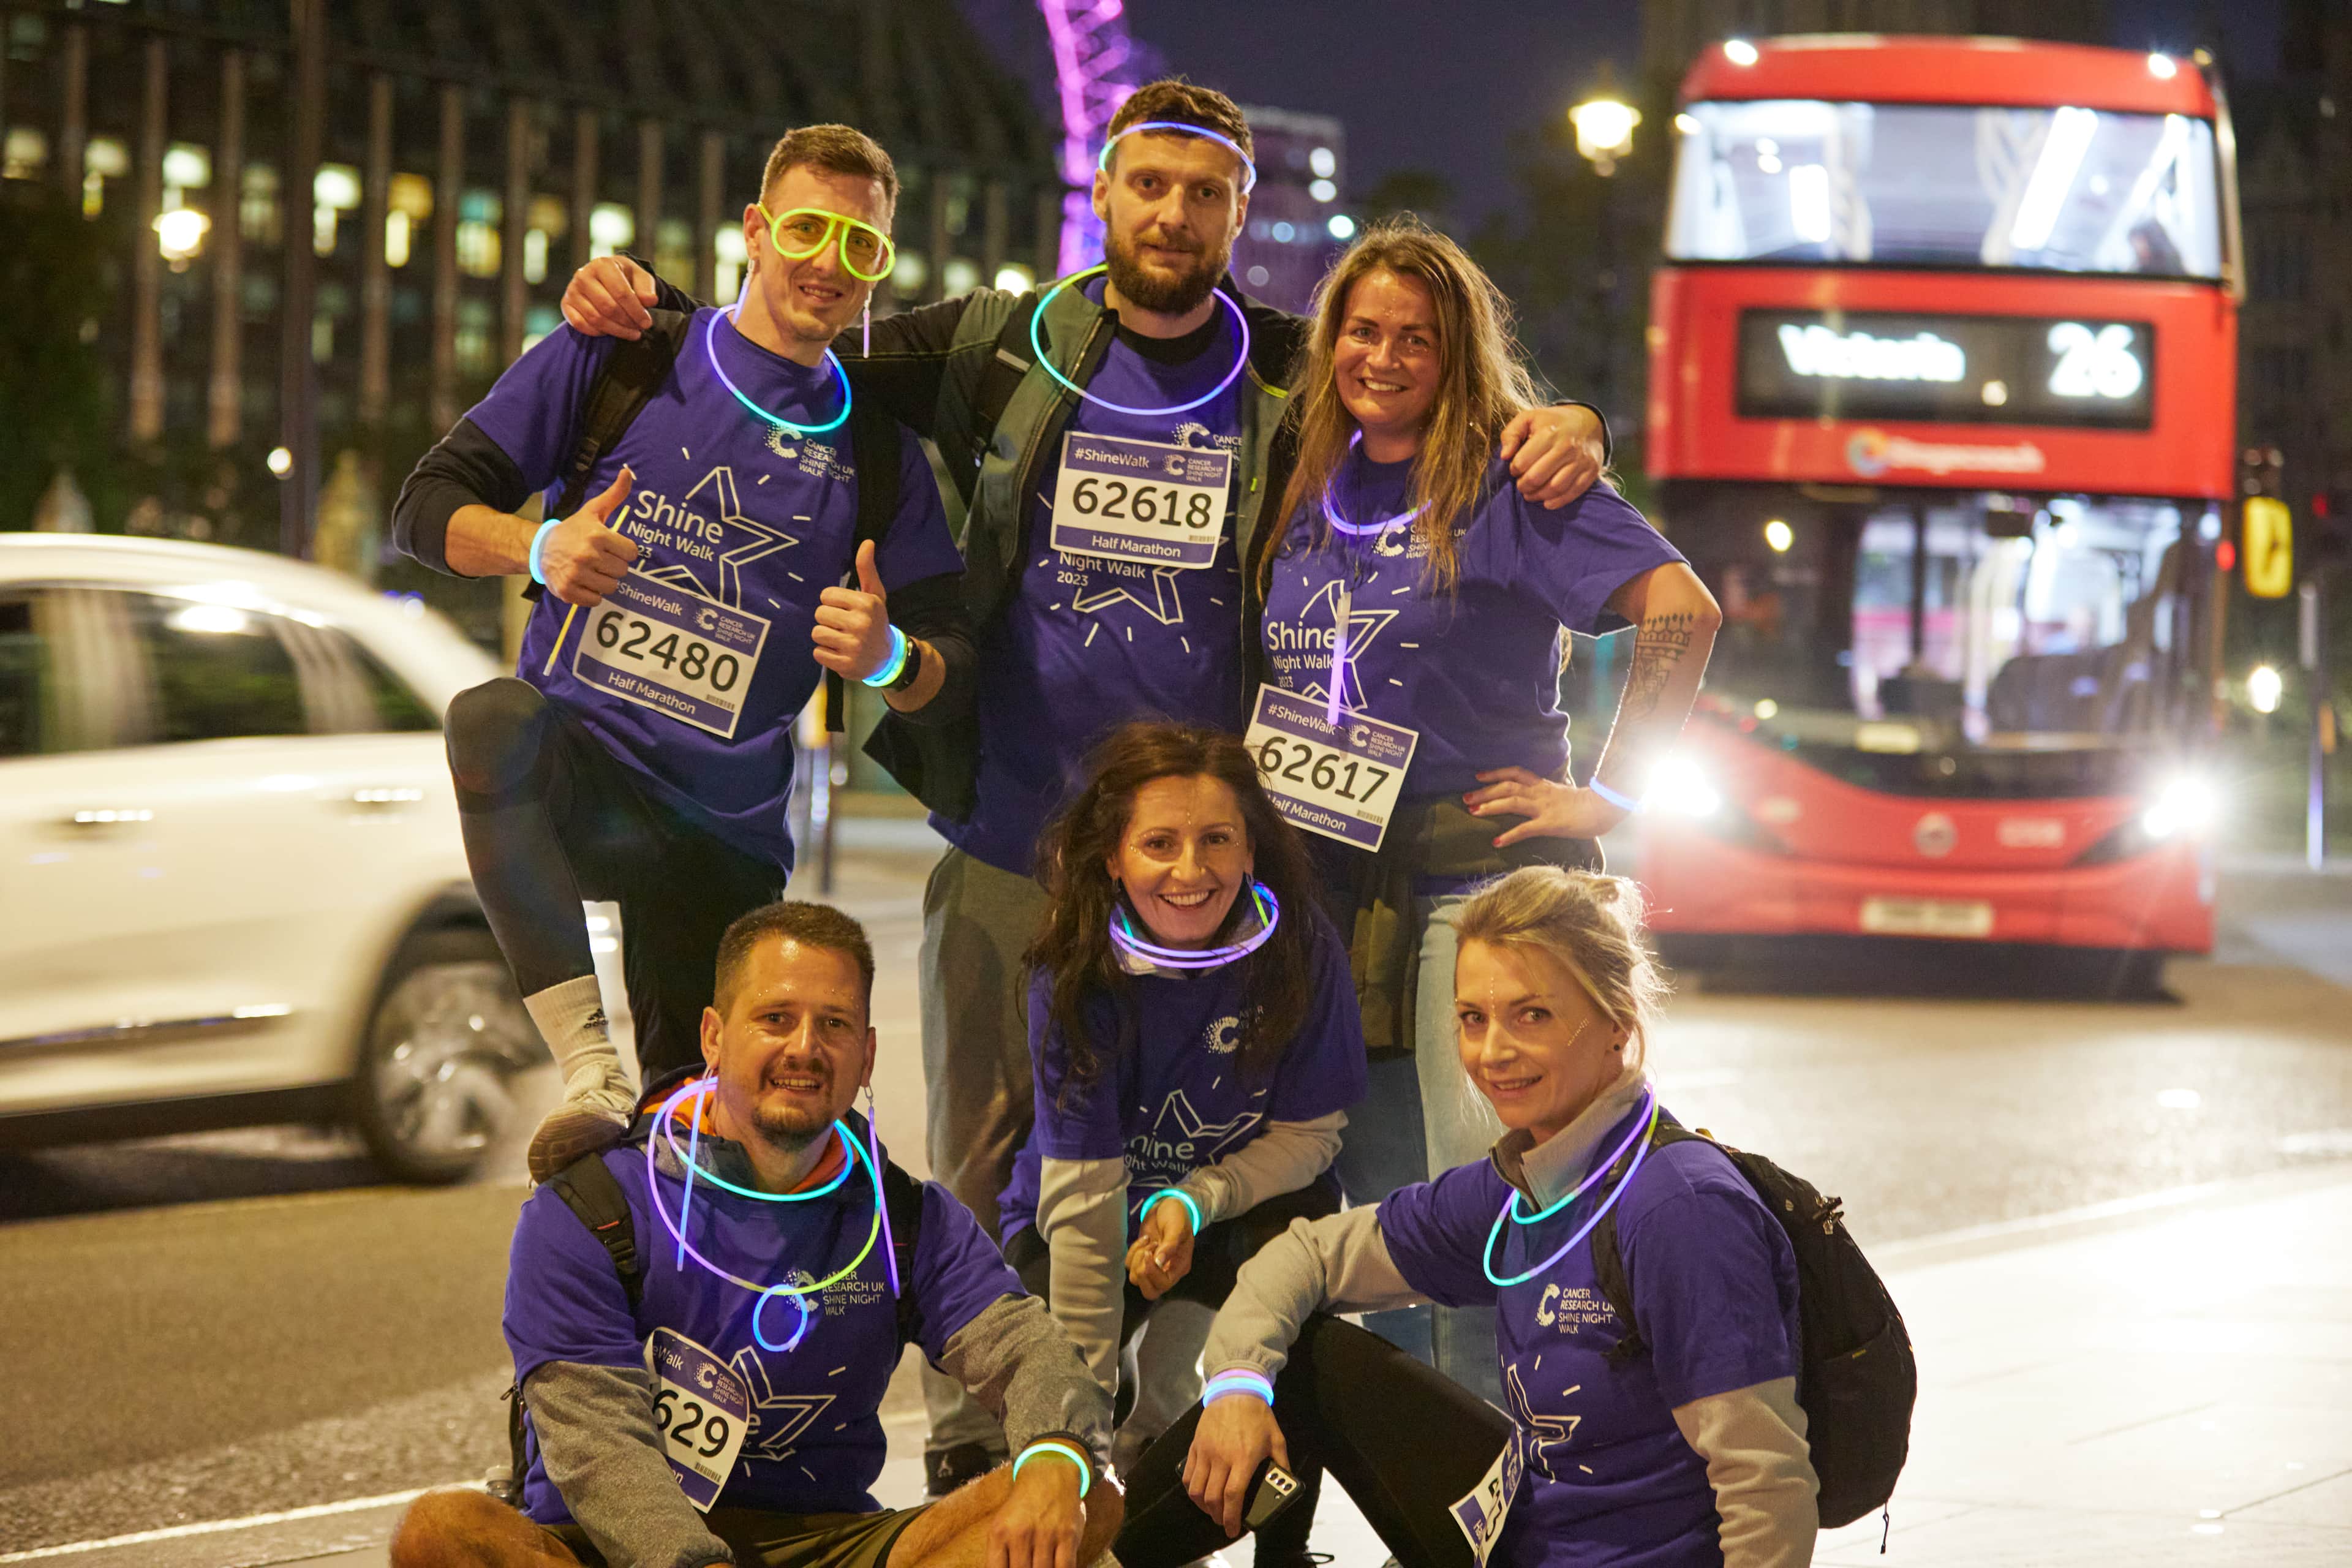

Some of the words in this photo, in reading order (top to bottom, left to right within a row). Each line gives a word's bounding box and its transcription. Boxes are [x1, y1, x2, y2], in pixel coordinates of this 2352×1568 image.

[2048, 322, 2143, 399] 26
[1213, 434, 1243, 446] CANCE
[800, 455, 827, 471] SHINE
[1074, 447, 1150, 468] #ShineWalk
[798, 462, 824, 478] WALK
[842, 466, 855, 476] UK
[1072, 478, 1212, 529] 62618
[633, 490, 723, 544] Shine
[627, 521, 672, 547] Night
[676, 535, 715, 562] Walk
[1091, 535, 1118, 549] Half
[1120, 540, 1181, 557] Marathon
[637, 545, 654, 558] 23
[1060, 552, 1102, 571] Night
[1106, 560, 1146, 578] Walk
[1057, 571, 1088, 586] 2023
[1267, 621, 1336, 650] Shine
[597, 611, 739, 692] 62480
[1273, 654, 1302, 673] Night
[1303, 654, 1333, 669] Walk
[608, 672, 636, 691] Half
[636, 684, 696, 714] Marathon
[1267, 704, 1336, 736] #ShineWalk
[1259, 736, 1389, 803] 62617
[1291, 803, 1347, 832] Marathon
[1125, 1154, 1146, 1172] ght
[822, 1282, 869, 1294] RESEARCH
[872, 1282, 884, 1292] UK
[1563, 1287, 1591, 1298] CANCER
[823, 1294, 846, 1305] SHINE
[850, 1294, 881, 1304] NIGHT
[1560, 1299, 1599, 1311] RESEARCH
[825, 1305, 845, 1316] WALK
[1558, 1312, 1580, 1323] SHINE
[1582, 1313, 1613, 1324] NIGHT
[1558, 1323, 1578, 1334] WALK
[652, 1389, 729, 1458] 629
